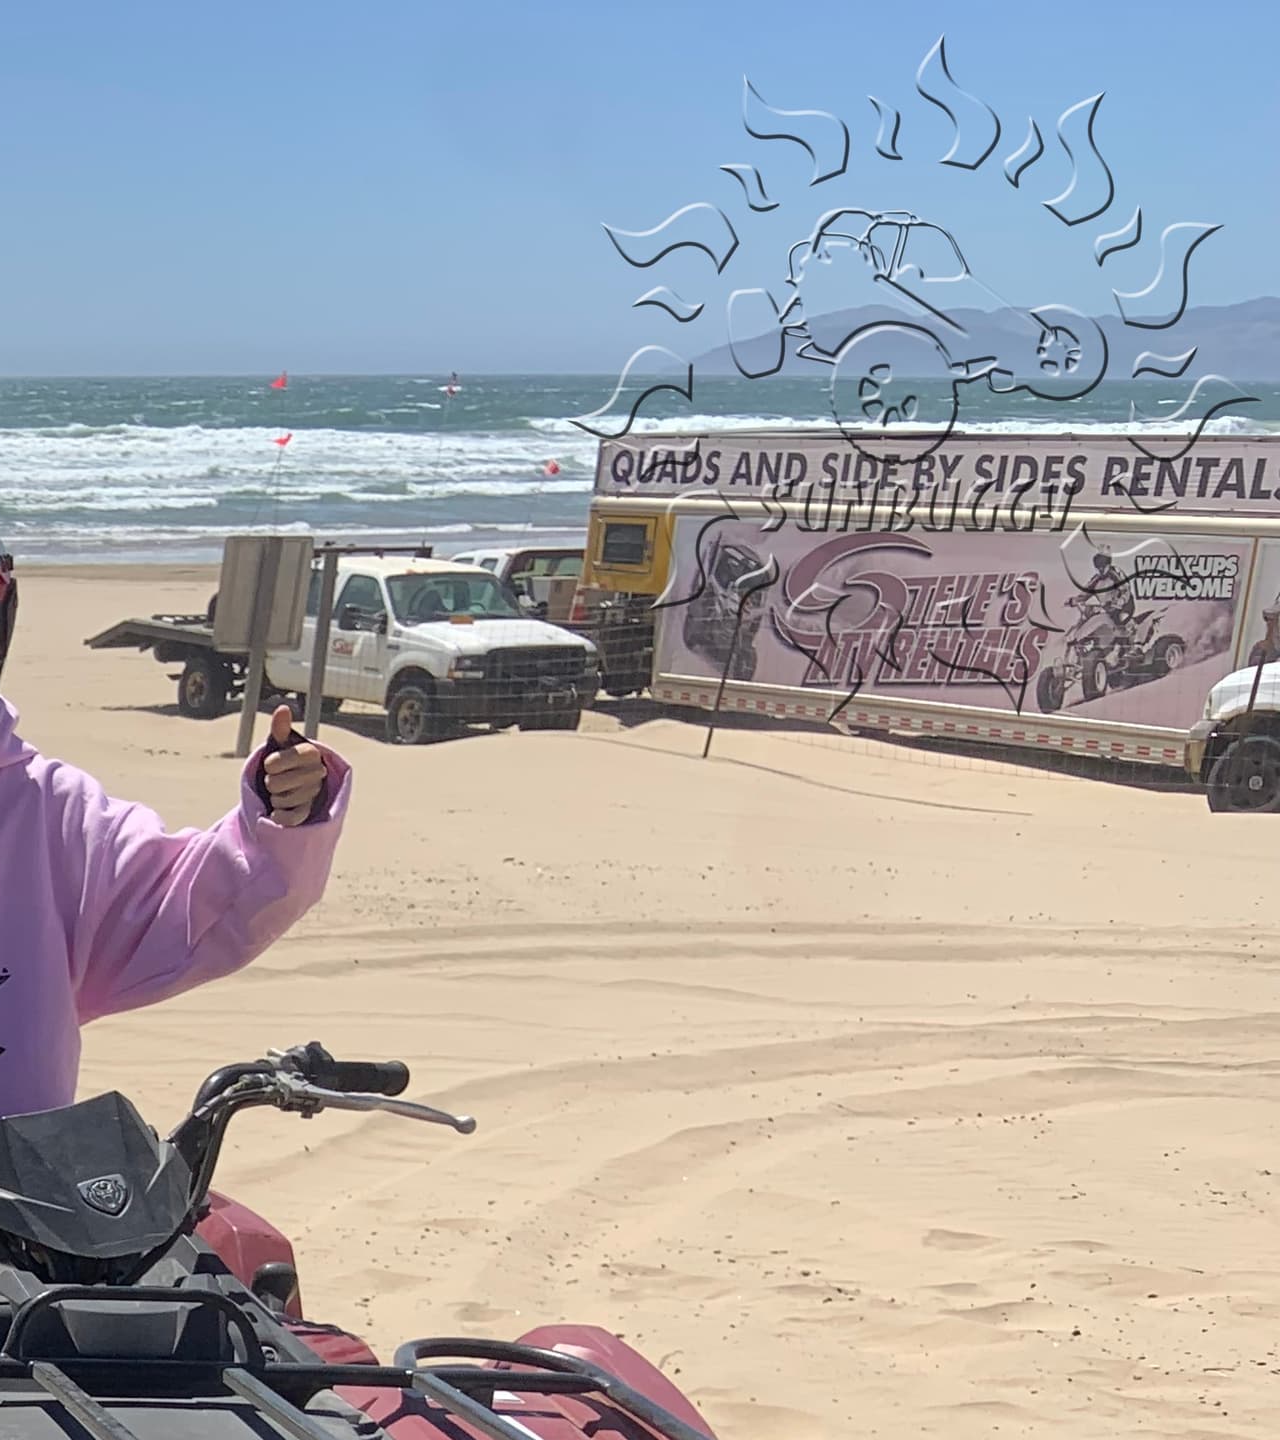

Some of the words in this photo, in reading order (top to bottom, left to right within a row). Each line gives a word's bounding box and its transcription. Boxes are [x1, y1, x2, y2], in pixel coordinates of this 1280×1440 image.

[610, 450, 722, 486] QUADS
[729, 451, 808, 488] AND
[819, 452, 901, 490] SIDE
[912, 454, 965, 492] BY
[974, 454, 1088, 495] SIDES
[1101, 456, 1280, 500] RENTAL
[1135, 554, 1241, 578] WALK-UPS
[1135, 577, 1236, 601] WELCOME
[801, 631, 879, 687] ATV
[876, 626, 1050, 687] RENTALS
